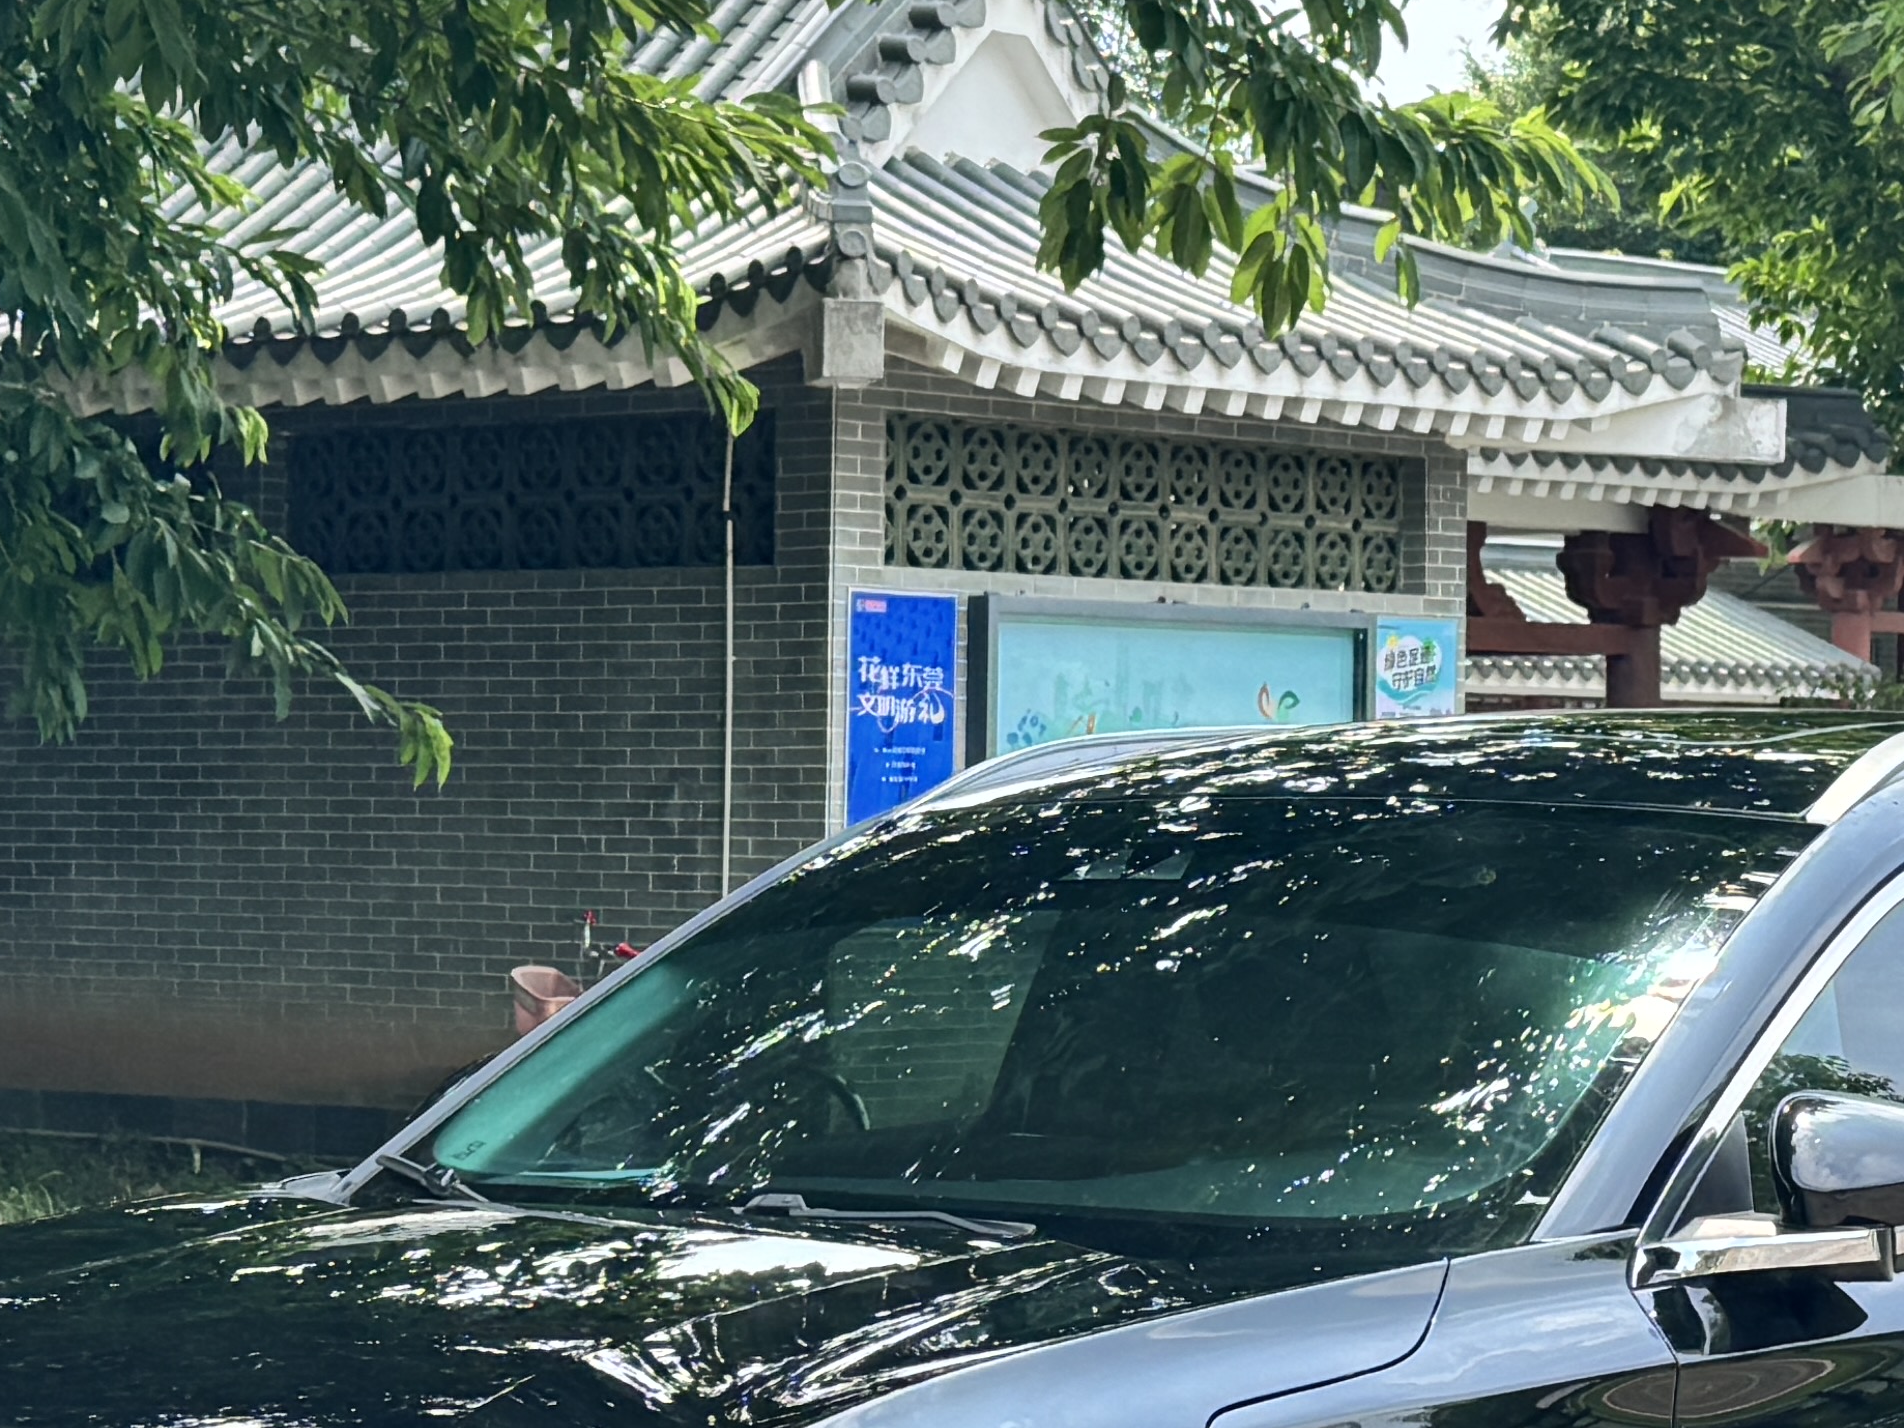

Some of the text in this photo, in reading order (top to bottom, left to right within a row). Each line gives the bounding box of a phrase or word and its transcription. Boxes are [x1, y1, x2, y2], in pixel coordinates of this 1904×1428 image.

[857, 655, 945, 690] 花样东莞
[856, 691, 946, 725] 文明游礼
